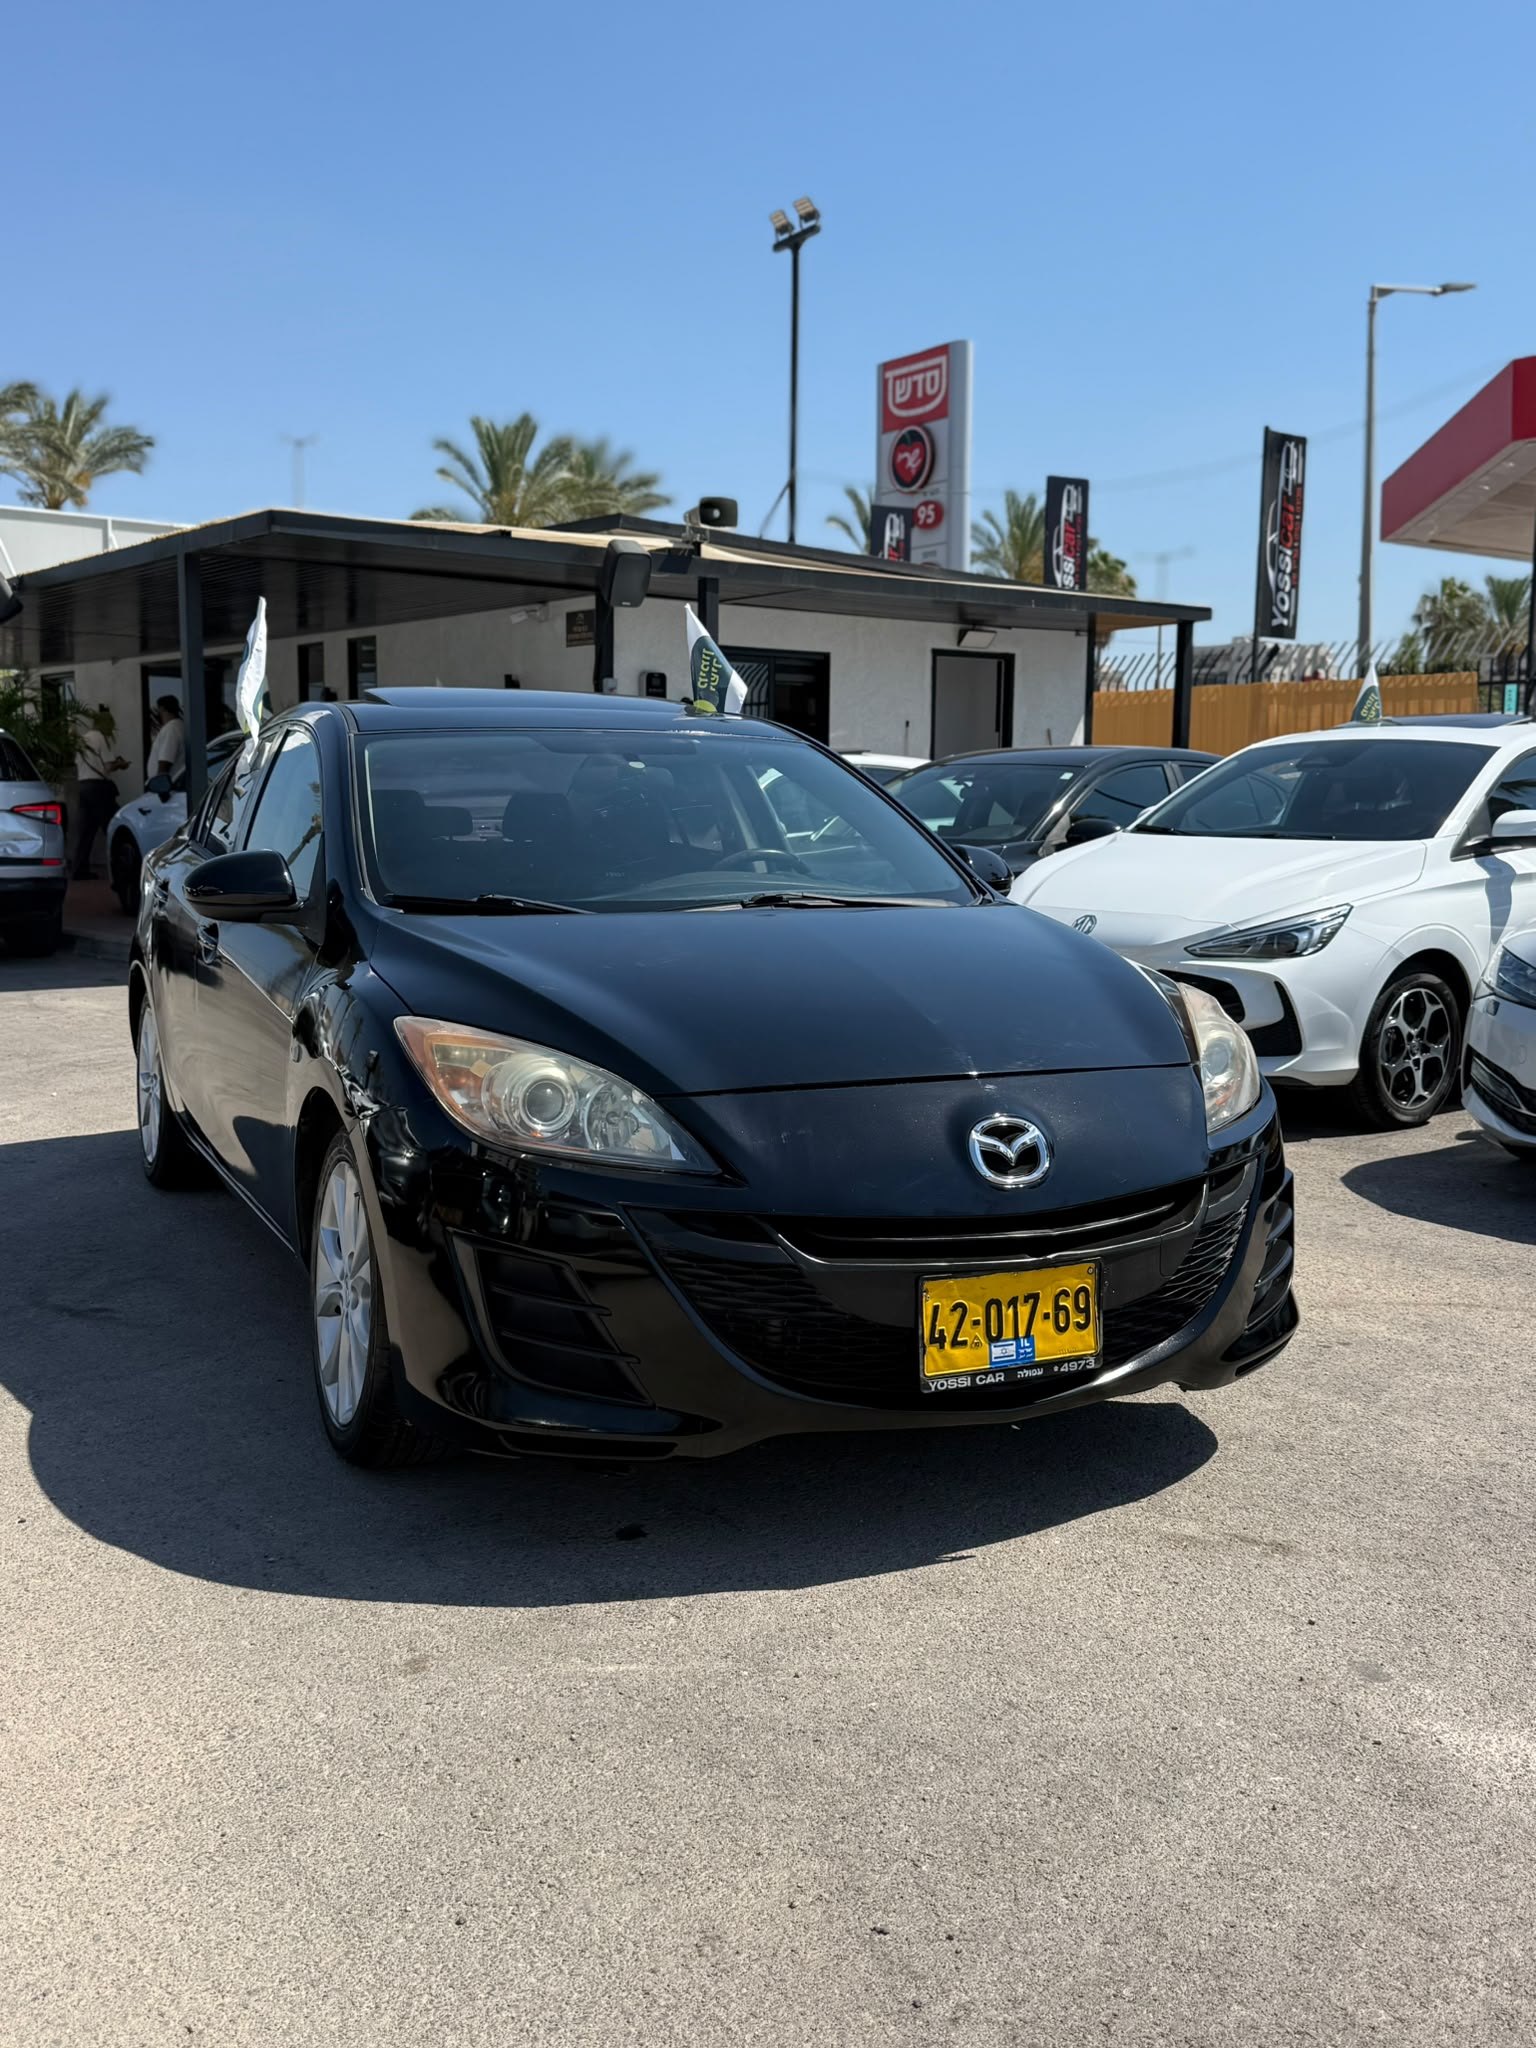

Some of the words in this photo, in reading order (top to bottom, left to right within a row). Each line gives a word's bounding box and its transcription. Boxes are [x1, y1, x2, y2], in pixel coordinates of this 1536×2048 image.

[895, 368, 940, 405] סדש
[917, 504, 936, 525] 95
[1020, 1338, 1031, 1348] IL
[929, 1376, 971, 1392] YOSSI
[975, 1372, 1006, 1386] CAR
[1017, 1367, 1044, 1379] עפולה
